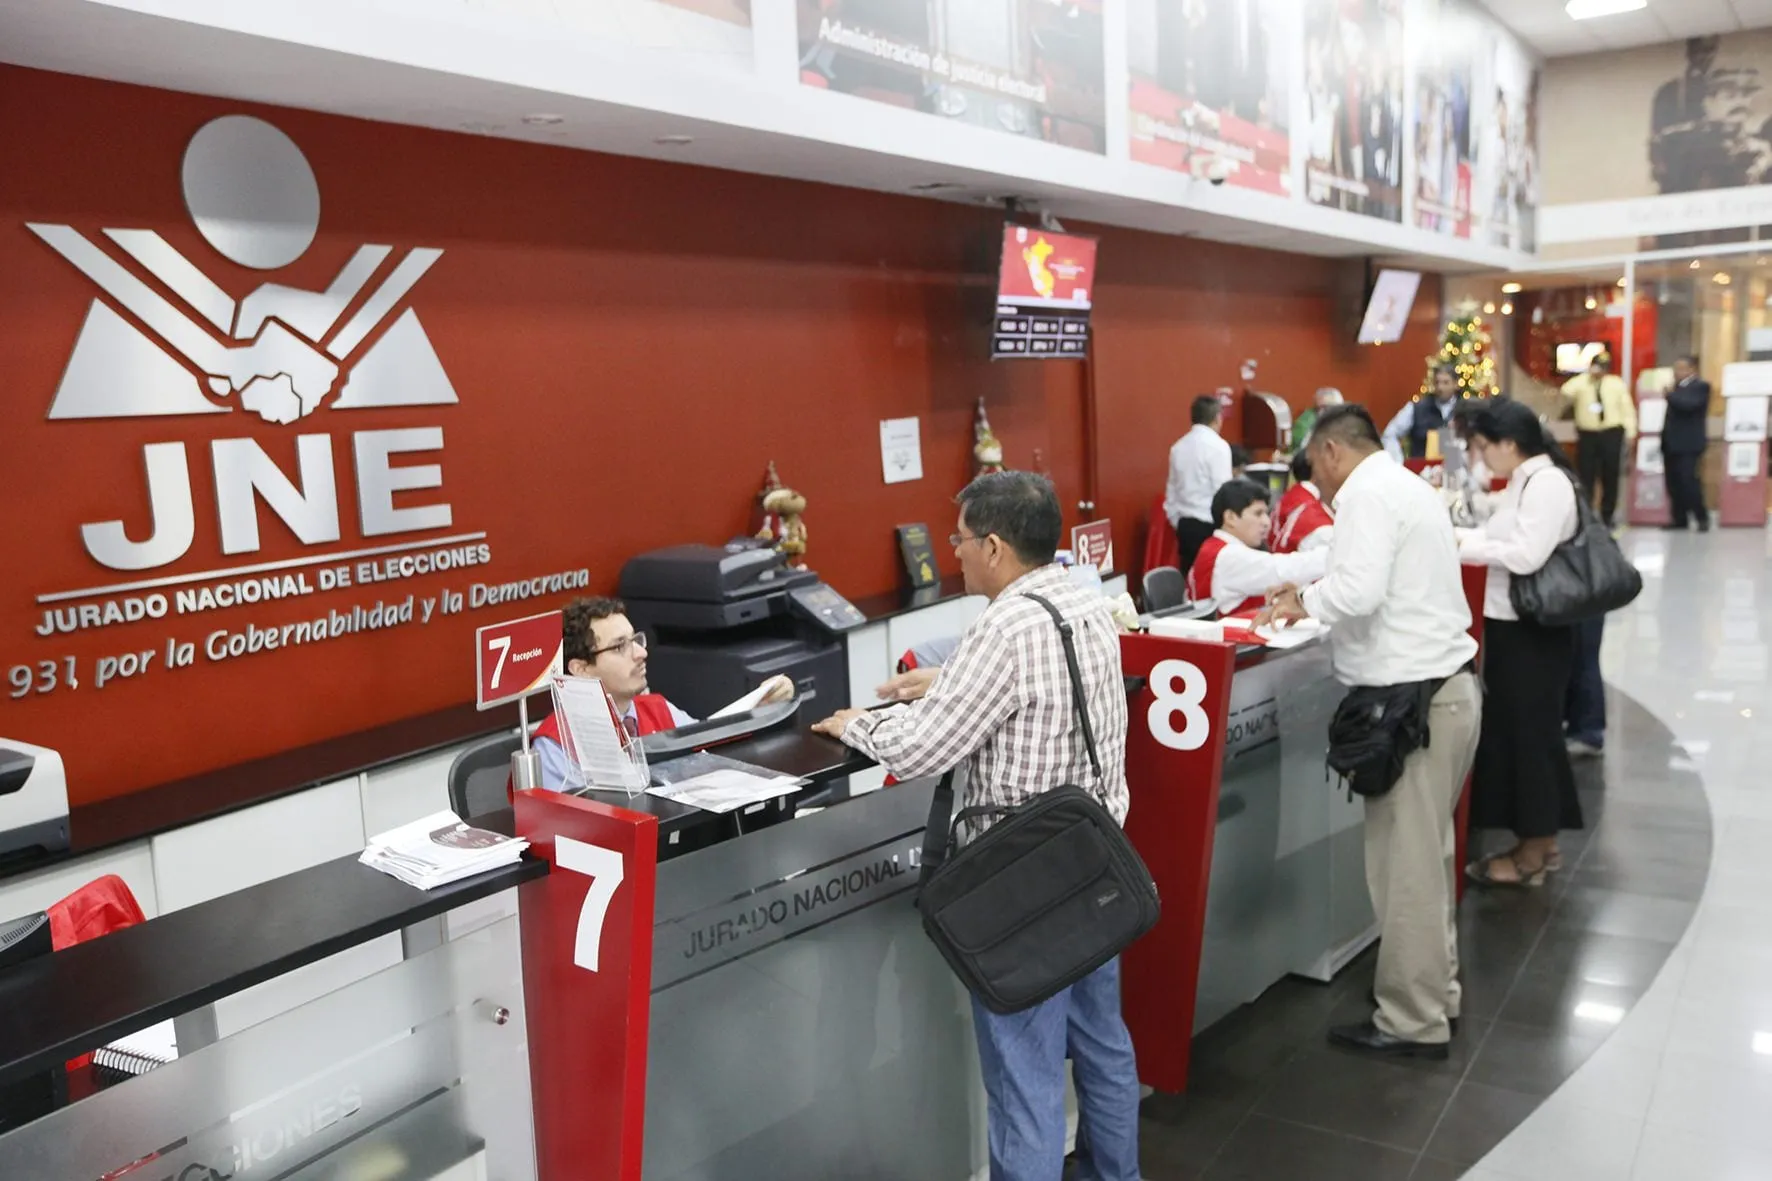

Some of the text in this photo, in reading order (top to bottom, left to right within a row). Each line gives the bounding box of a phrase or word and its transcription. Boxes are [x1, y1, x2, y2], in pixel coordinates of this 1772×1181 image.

[819, 17, 930, 69] Administración
[931, 51, 949, 76] de
[80, 427, 453, 570] JNE
[36, 543, 491, 636] JURADO NACIONAL DE ELECCIONES
[1079, 533, 1090, 565] 8
[95, 650, 156, 688] por
[165, 637, 195, 669] la
[206, 603, 413, 660] Gobernabilidad
[420, 598, 436, 625] y
[441, 588, 463, 614] la
[470, 568, 590, 609] Democracia
[488, 636, 543, 689] 7 Recepción
[1147, 658, 1210, 751] 8
[554, 834, 624, 973] 7
[684, 901, 787, 958] JURADO
[794, 854, 905, 916] NACIONAL
